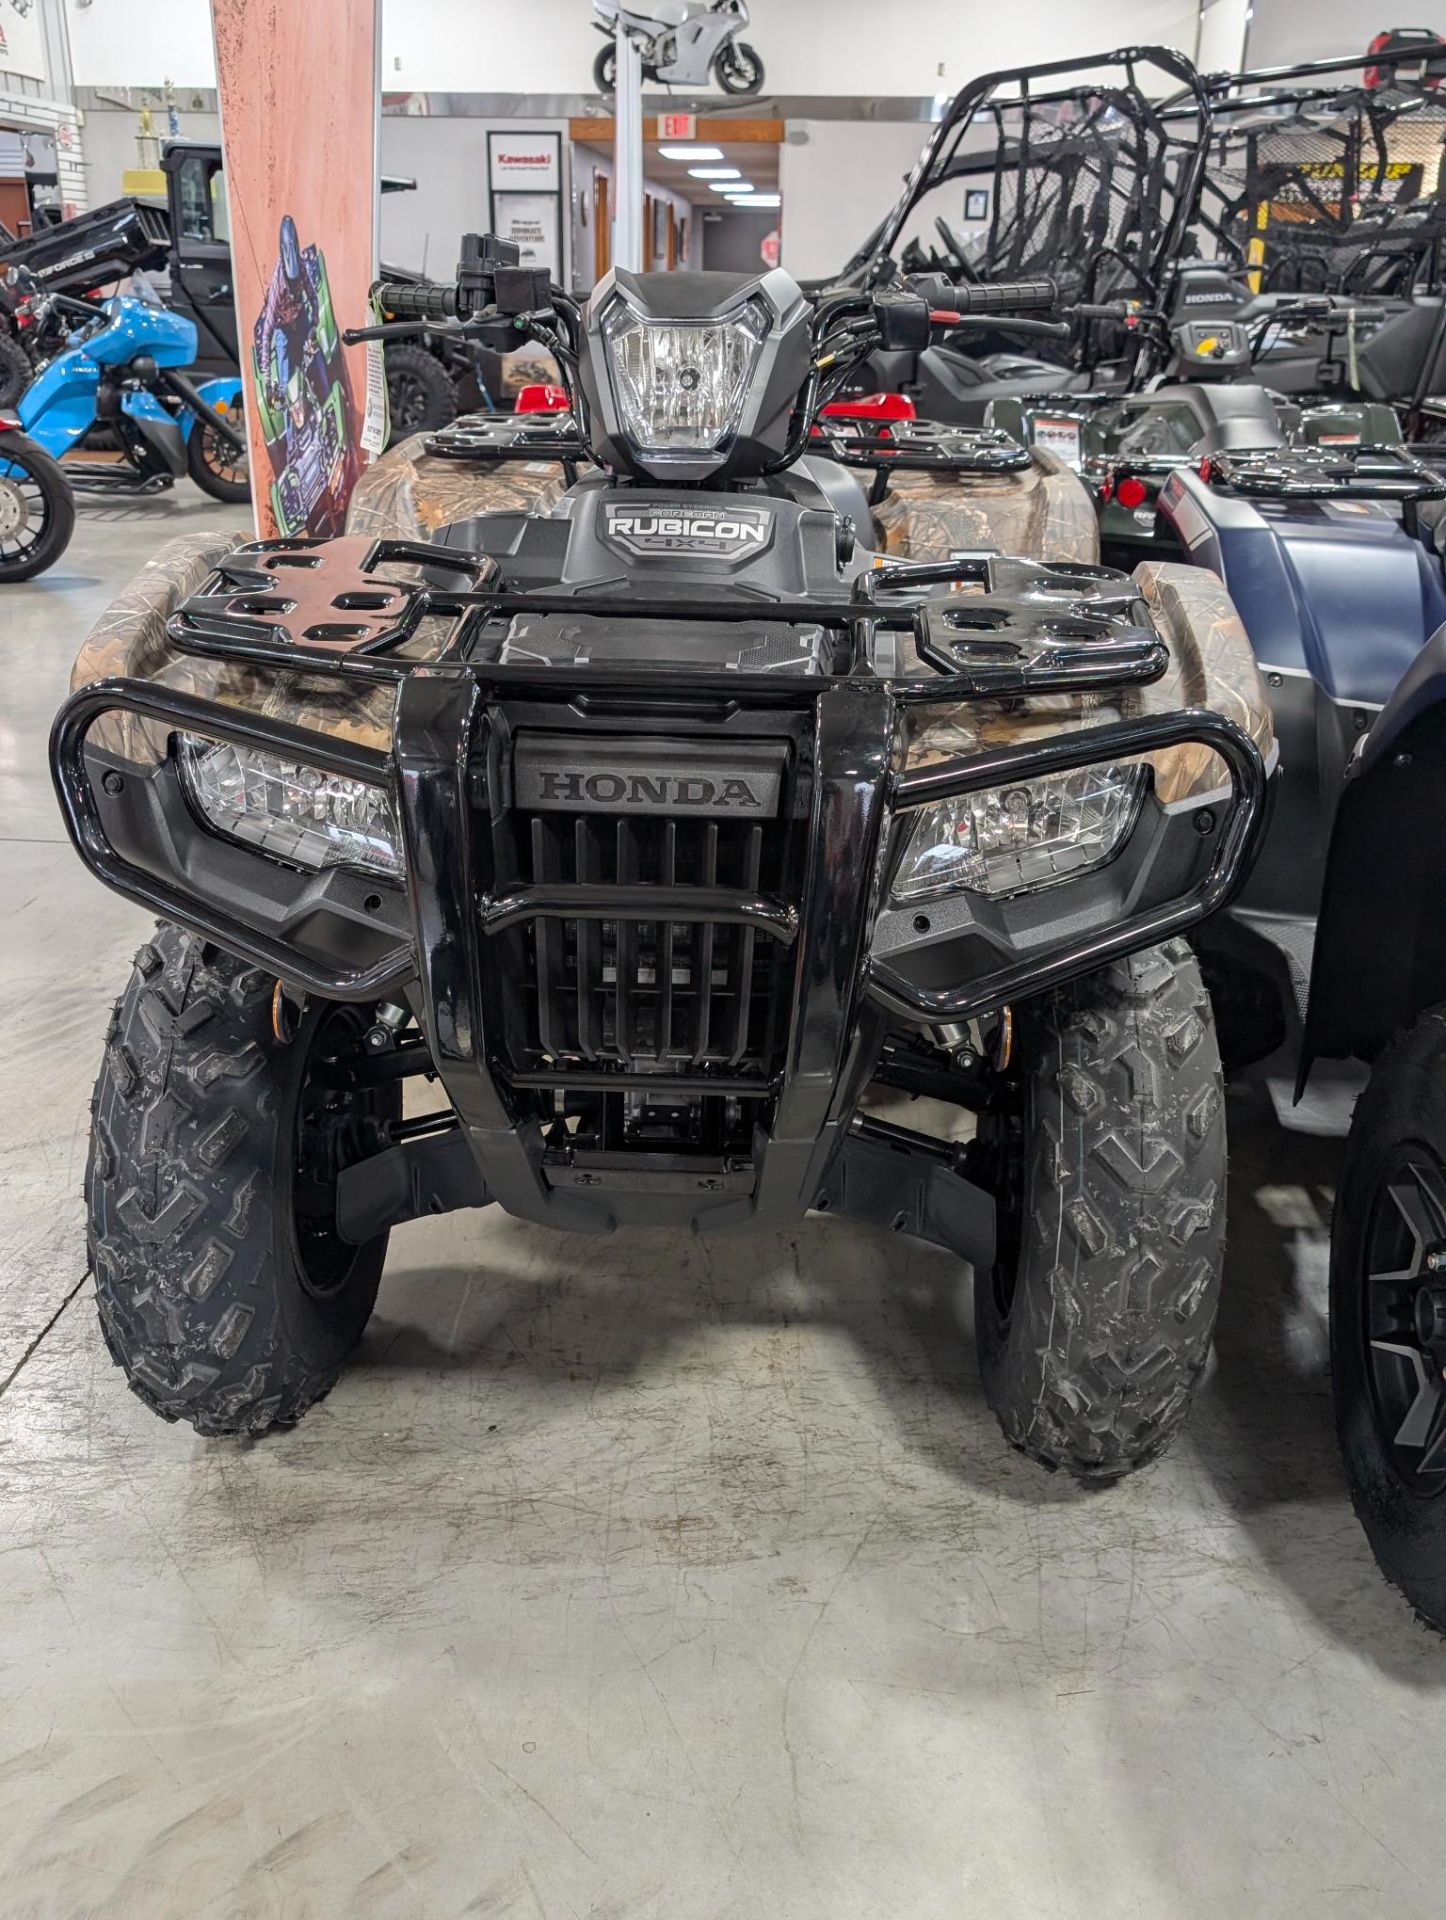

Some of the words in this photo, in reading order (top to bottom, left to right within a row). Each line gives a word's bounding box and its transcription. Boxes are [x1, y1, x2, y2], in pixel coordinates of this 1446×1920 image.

[498, 154, 551, 164] Kawasaki
[1185, 292, 1234, 304] HONDA
[650, 509, 726, 520] FOREMAN
[608, 518, 765, 542] RUBICON
[538, 771, 762, 808] HONDA
